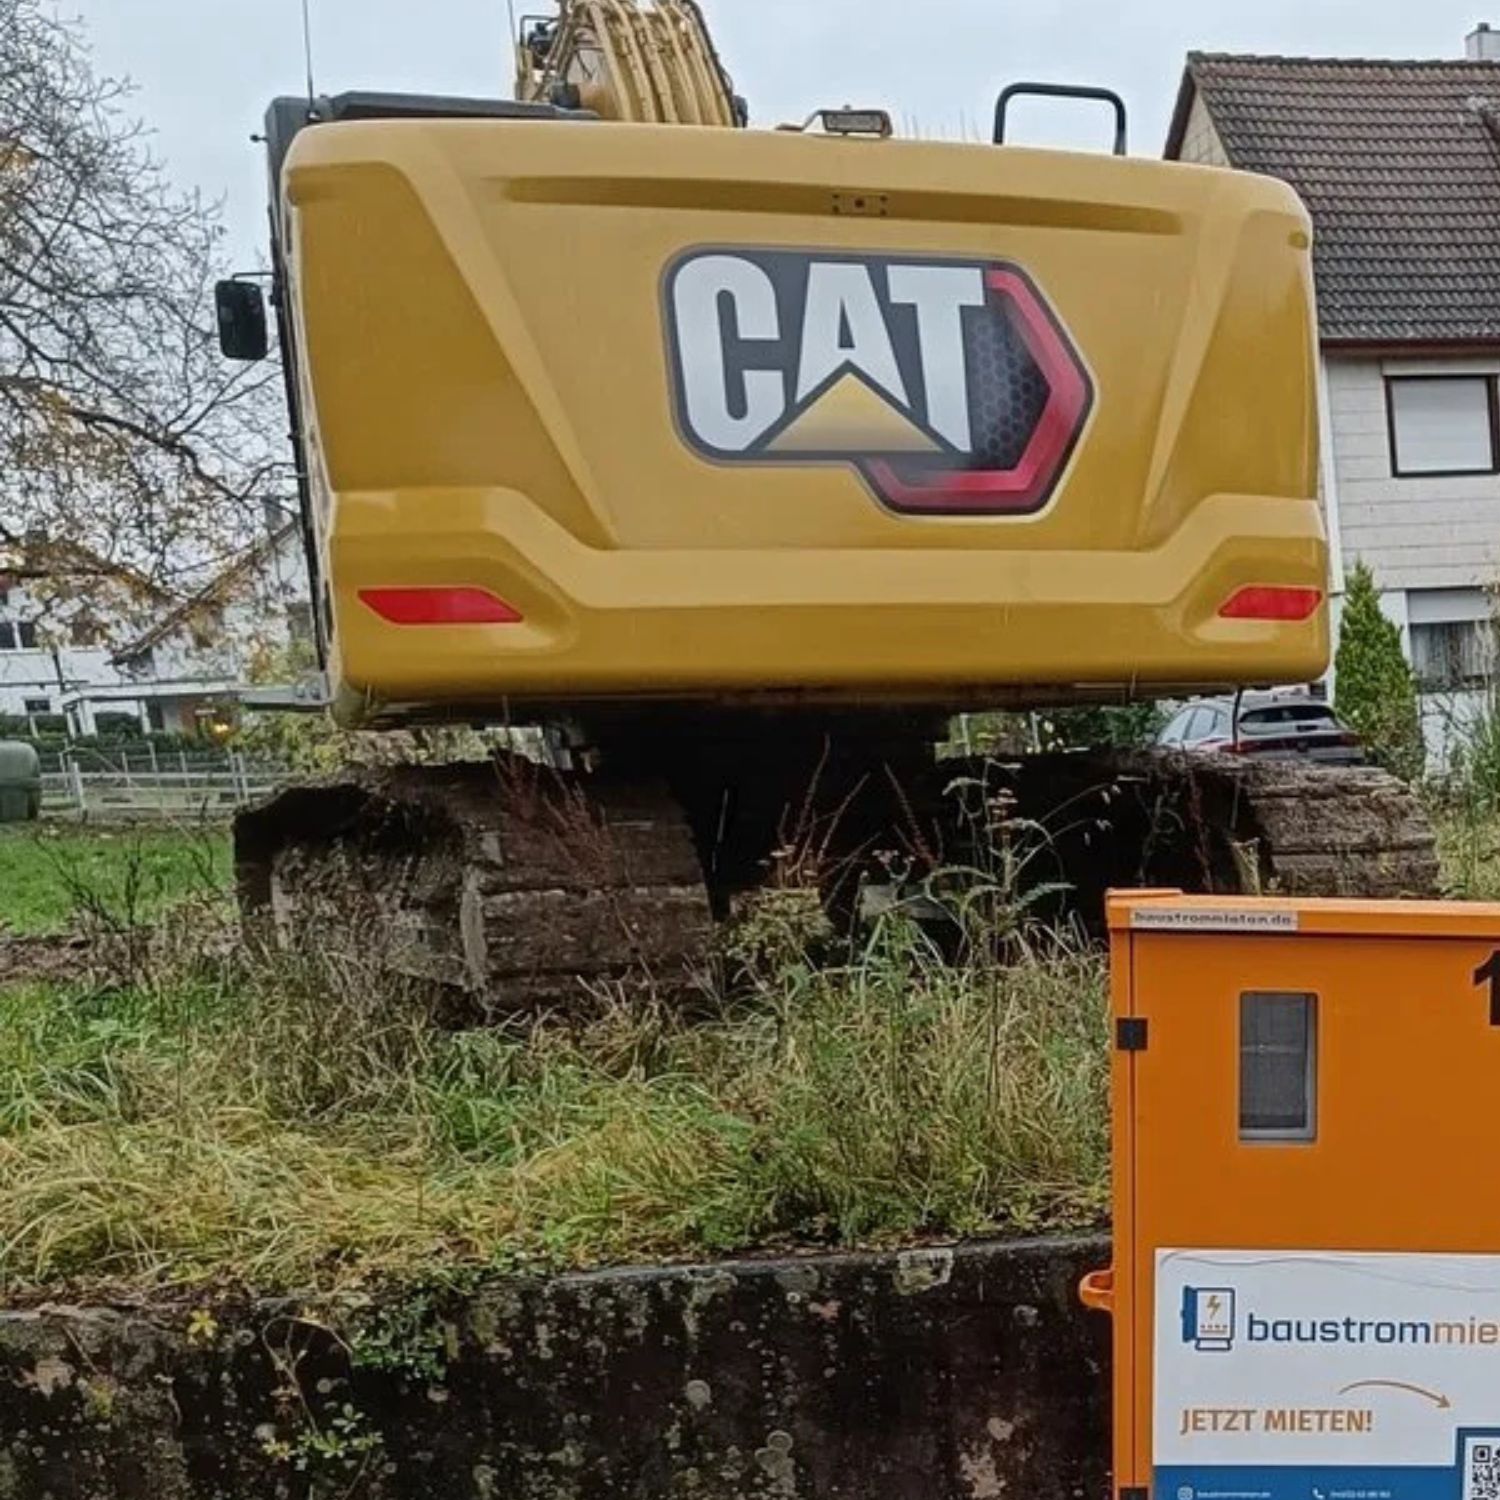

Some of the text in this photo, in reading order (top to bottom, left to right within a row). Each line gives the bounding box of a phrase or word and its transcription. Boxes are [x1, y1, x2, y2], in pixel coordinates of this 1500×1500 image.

[673, 254, 986, 453] CAT
[1180, 1409, 1373, 1435] JETZT MIETEN!
